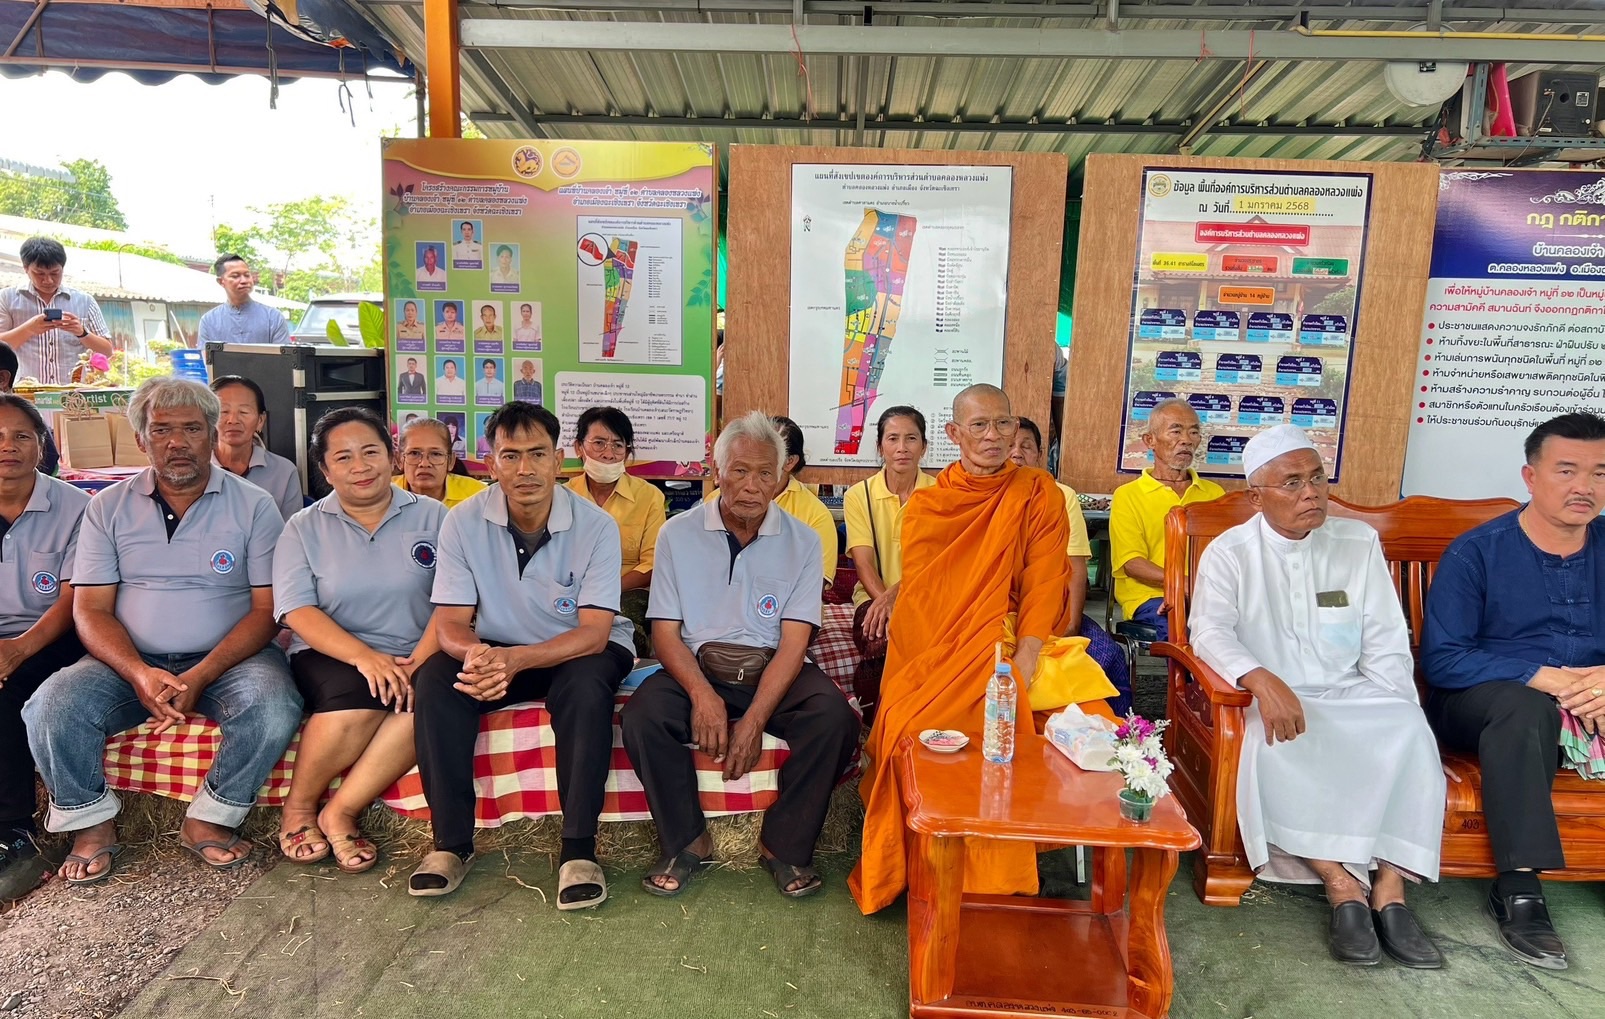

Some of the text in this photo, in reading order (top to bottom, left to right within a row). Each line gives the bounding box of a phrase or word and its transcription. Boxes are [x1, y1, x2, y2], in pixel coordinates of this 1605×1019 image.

[1173, 179, 1363, 199] ข้อมูล พื้นที่องค์การบริหารส่วนตำบลคลองหลวงแพ่ง
[1198, 203, 1208, 213] ณ
[1239, 200, 1243, 208] 1
[1247, 201, 1283, 211] มกราคม
[1285, 201, 1309, 211] 2568
[1533, 241, 1605, 258] บ้านคลองเจ้า
[1539, 285, 1559, 300] หมู่ที่
[1561, 290, 1575, 298] ๑๒
[1576, 287, 1605, 302] เป็นหมู่
[1429, 303, 1486, 312] ความสามัคคี
[1487, 304, 1532, 313] สมานฉันท์
[1438, 320, 1566, 333] ประชาชนแสดงความจงรักภักดี
[1567, 354, 1588, 368] หมู่ที่
